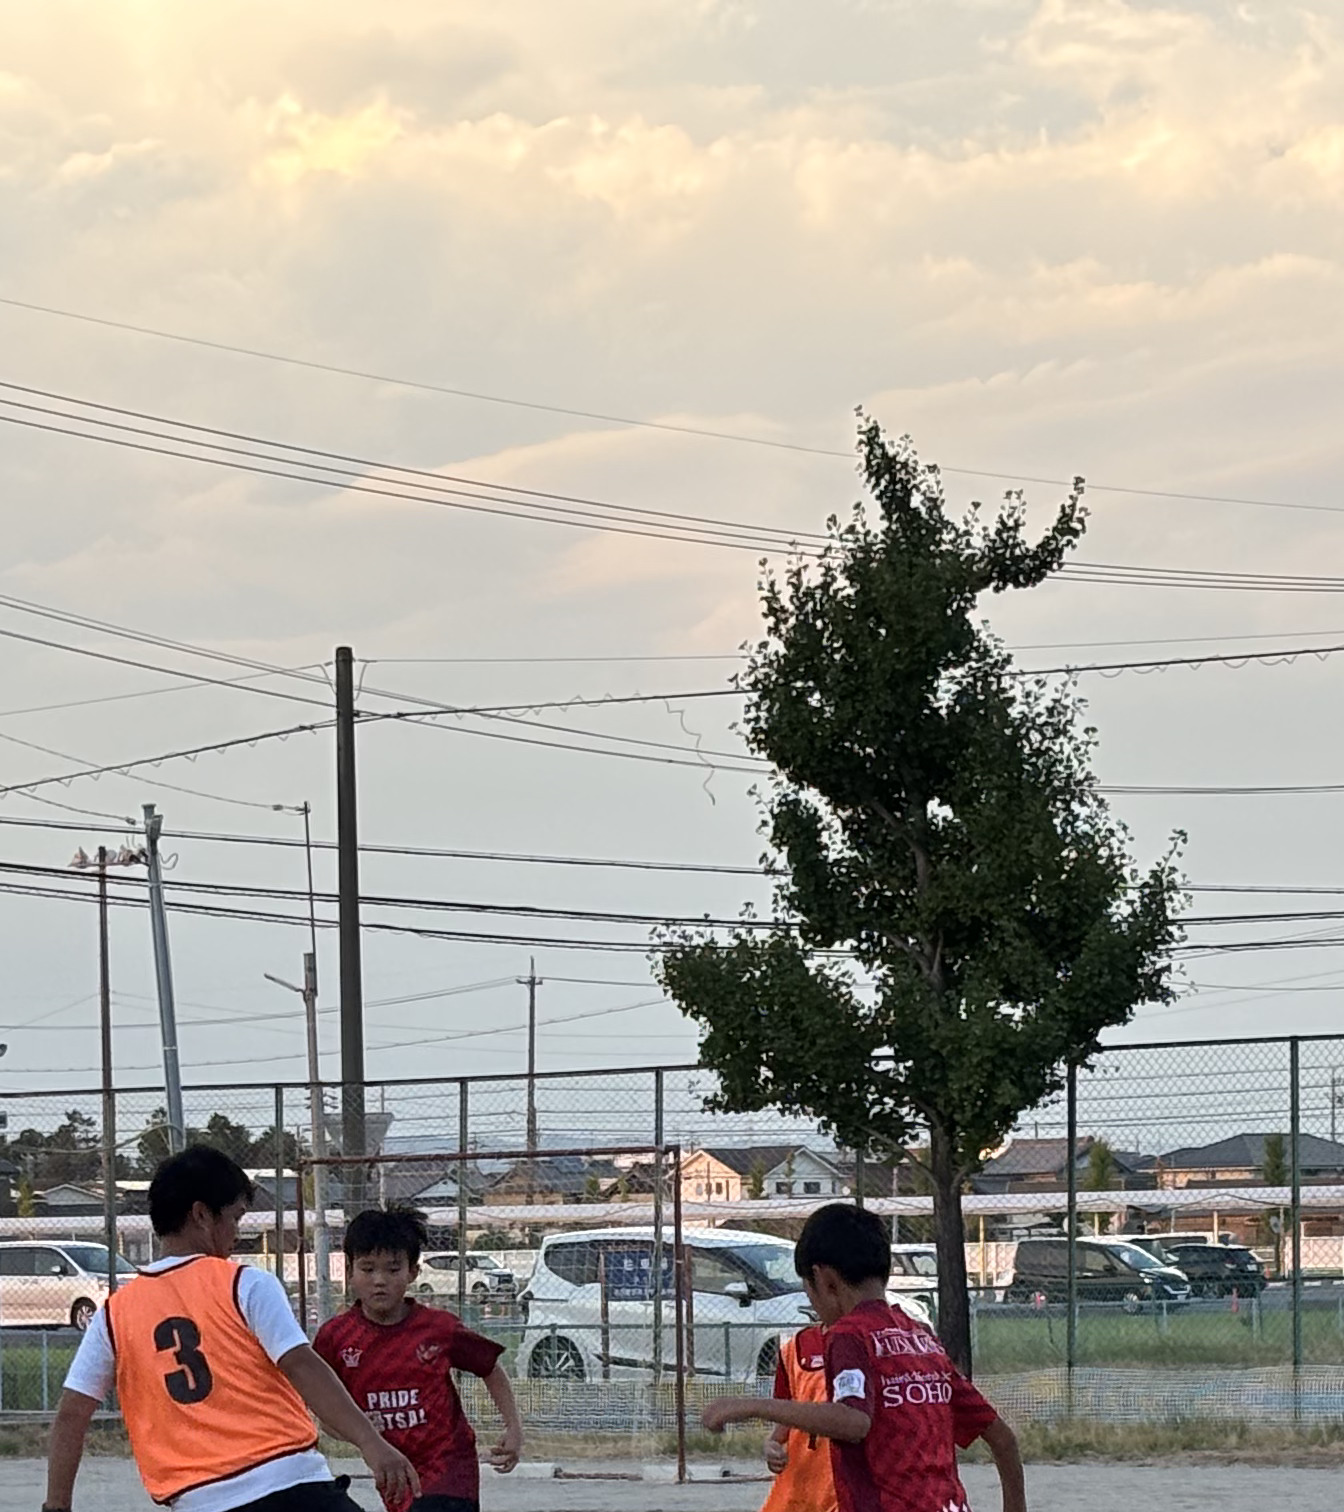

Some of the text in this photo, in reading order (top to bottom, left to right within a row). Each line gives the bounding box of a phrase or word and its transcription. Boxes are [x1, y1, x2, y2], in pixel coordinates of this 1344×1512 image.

[154, 1316, 213, 1405] 3
[367, 1389, 420, 1409] PRIDE
[882, 1382, 953, 1408] SOHO
